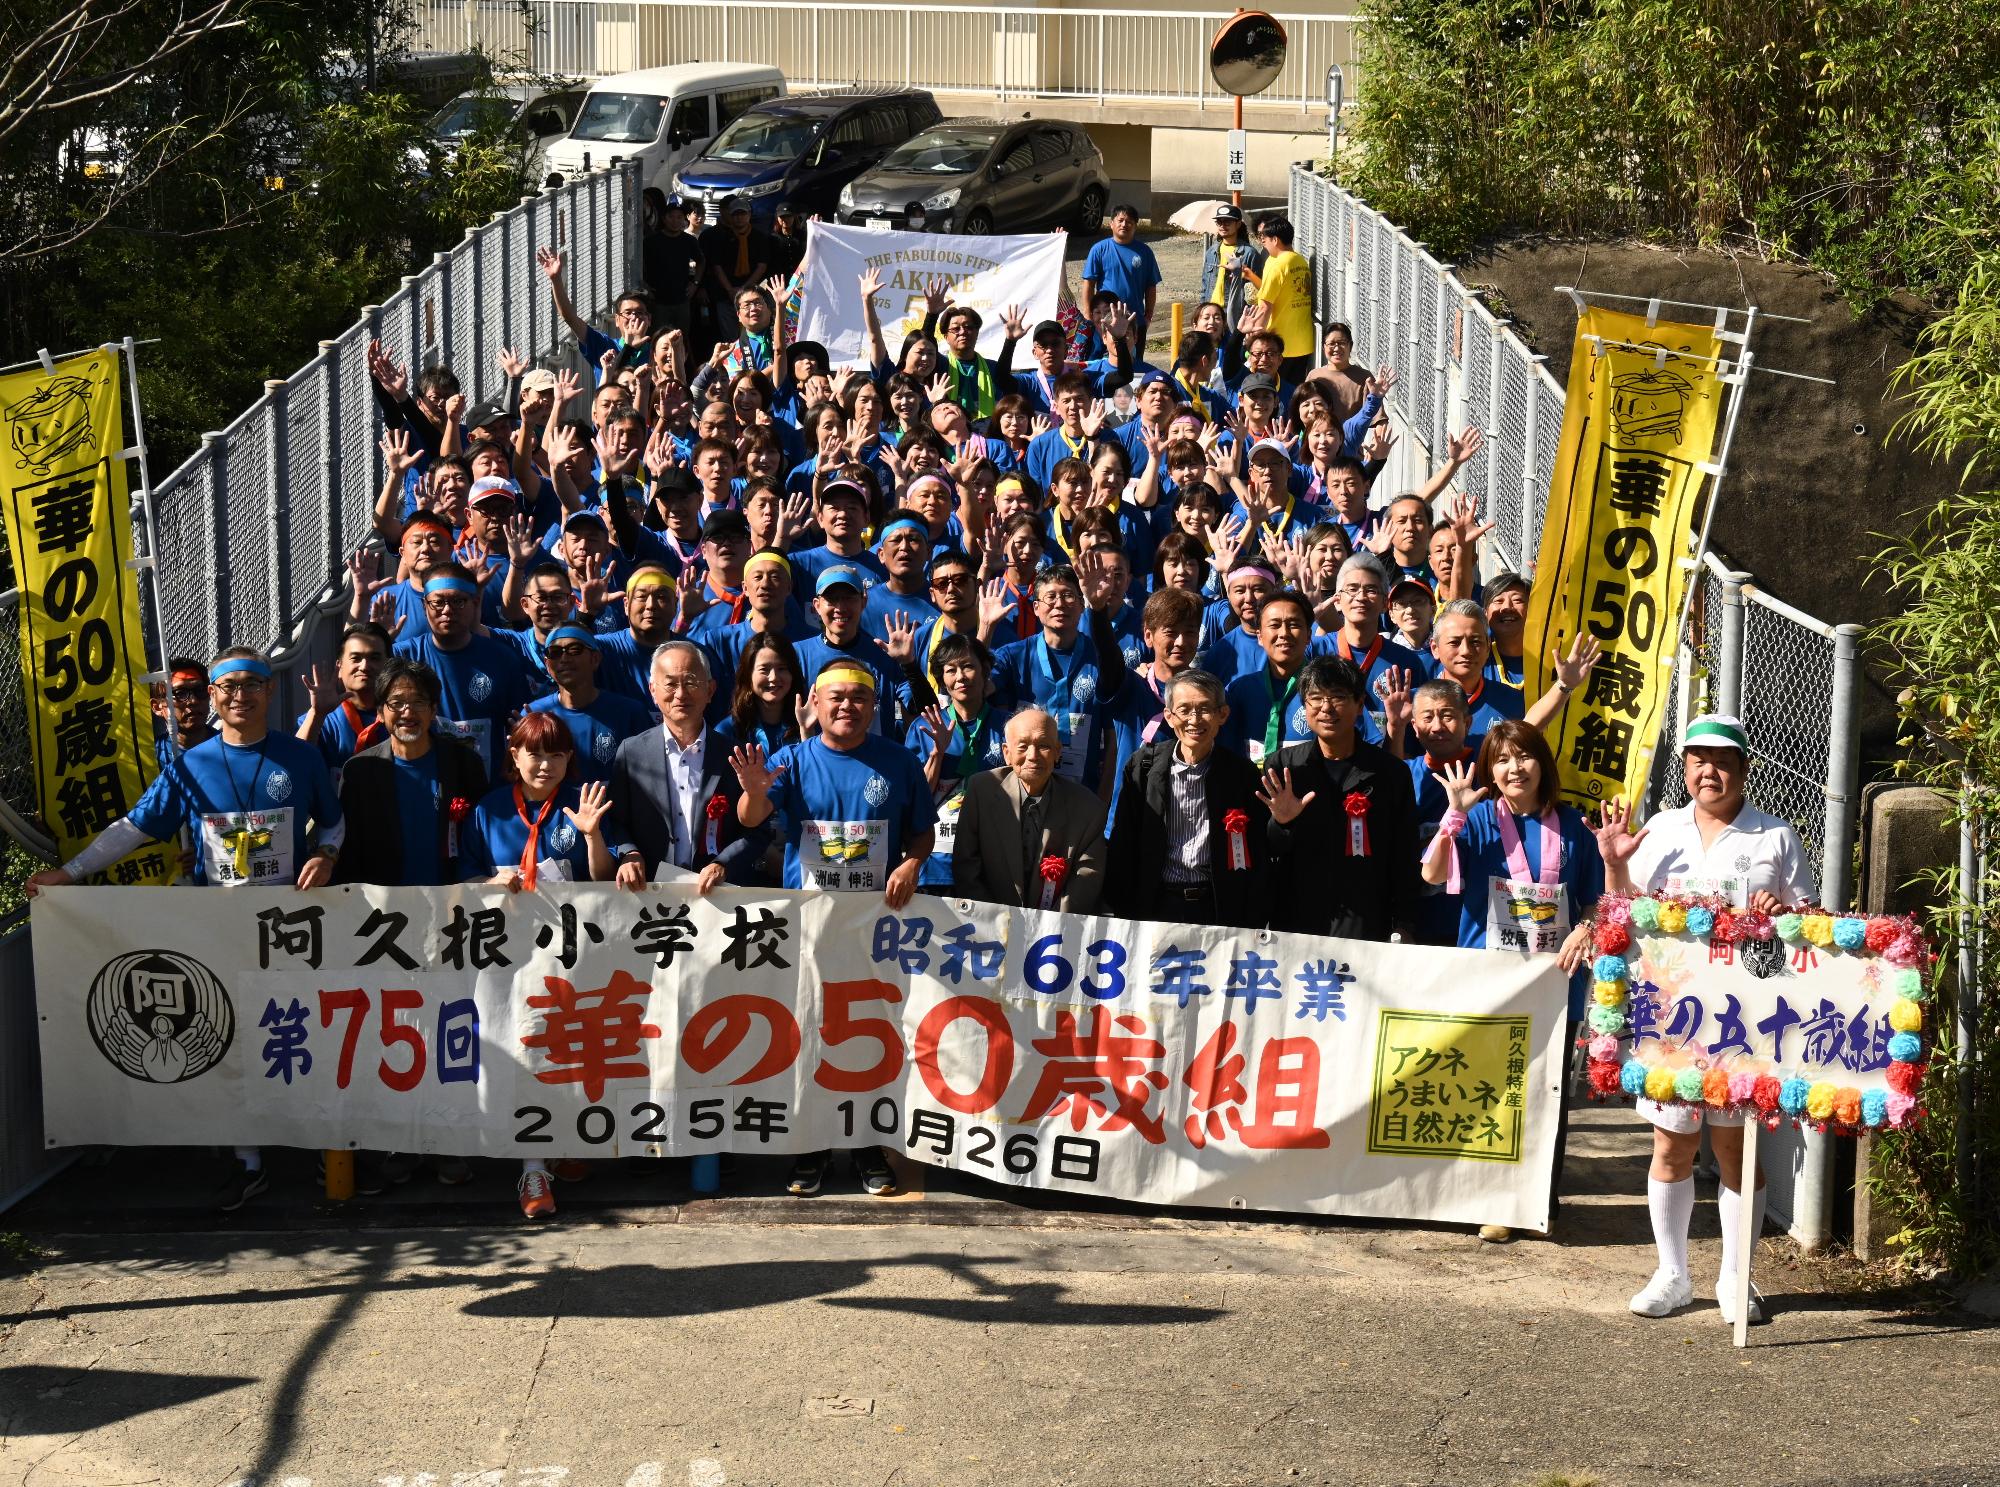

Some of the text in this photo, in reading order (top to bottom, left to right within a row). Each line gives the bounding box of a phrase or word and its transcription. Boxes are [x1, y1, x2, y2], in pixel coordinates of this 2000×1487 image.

[1230, 150, 1244, 185] 注意
[864, 249, 1003, 276] THE FABULOUS FIFTY
[890, 268, 977, 293] AKUNE
[1571, 456, 1671, 785] 華の50歳組
[31, 479, 128, 839] 華の50歳組
[253, 859, 279, 878] 康治
[848, 871, 874, 888] 伸治
[257, 902, 1357, 1023] 阿久根小学校 昭和63年卒業
[1709, 937, 1819, 973] 阿 小
[131, 969, 187, 1015] 阿
[1620, 979, 1896, 1074] 華の五十歳組
[258, 969, 1331, 1150] 第75回 華の50歳組
[1390, 1046, 1470, 1077] アクネ
[1505, 1025, 1528, 1108] 阿久根特産
[1387, 1079, 1501, 1111] うまいネ
[513, 1096, 1101, 1183] 2025年 10月26日
[1382, 1111, 1505, 1147] 自然だネ
